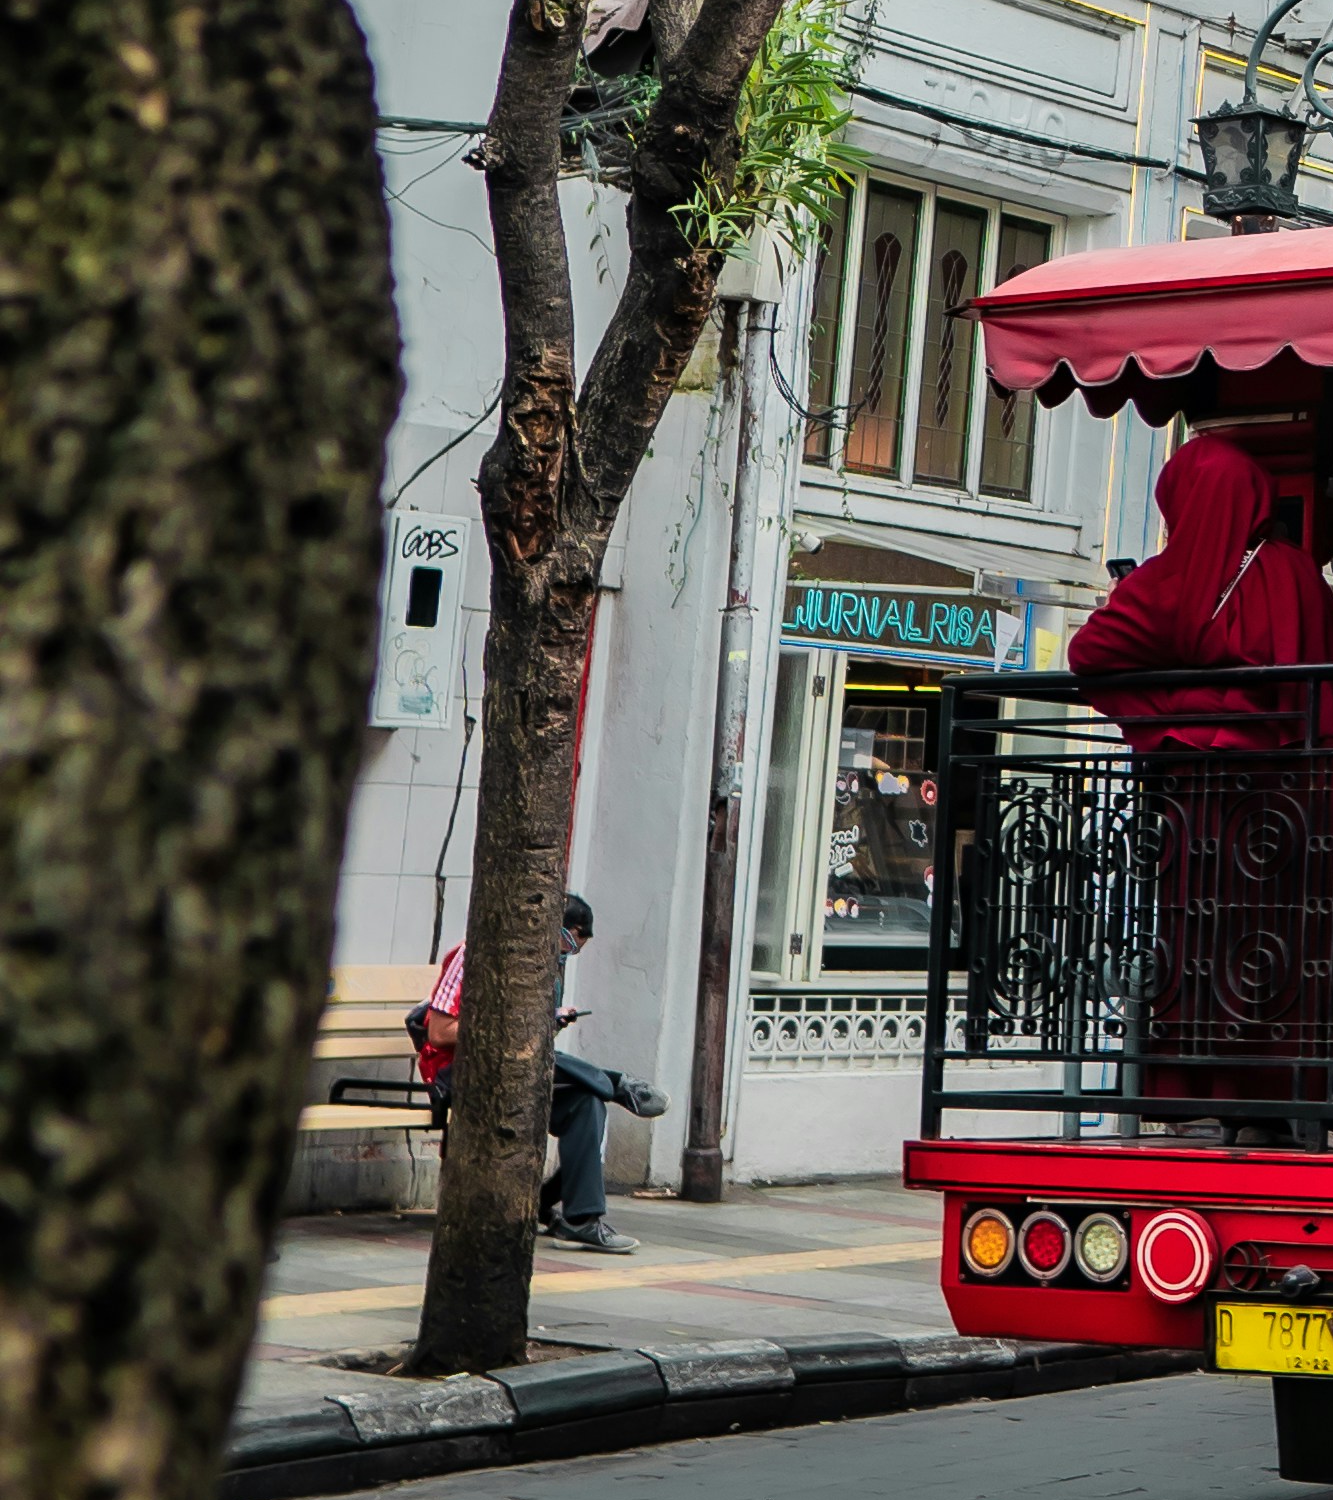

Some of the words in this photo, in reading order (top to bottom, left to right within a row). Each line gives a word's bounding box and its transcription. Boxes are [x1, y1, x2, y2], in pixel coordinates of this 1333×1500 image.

[930, 601, 998, 648] RISA
[1219, 1308, 1233, 1348] D
[1262, 1310, 1328, 1352] 7877
